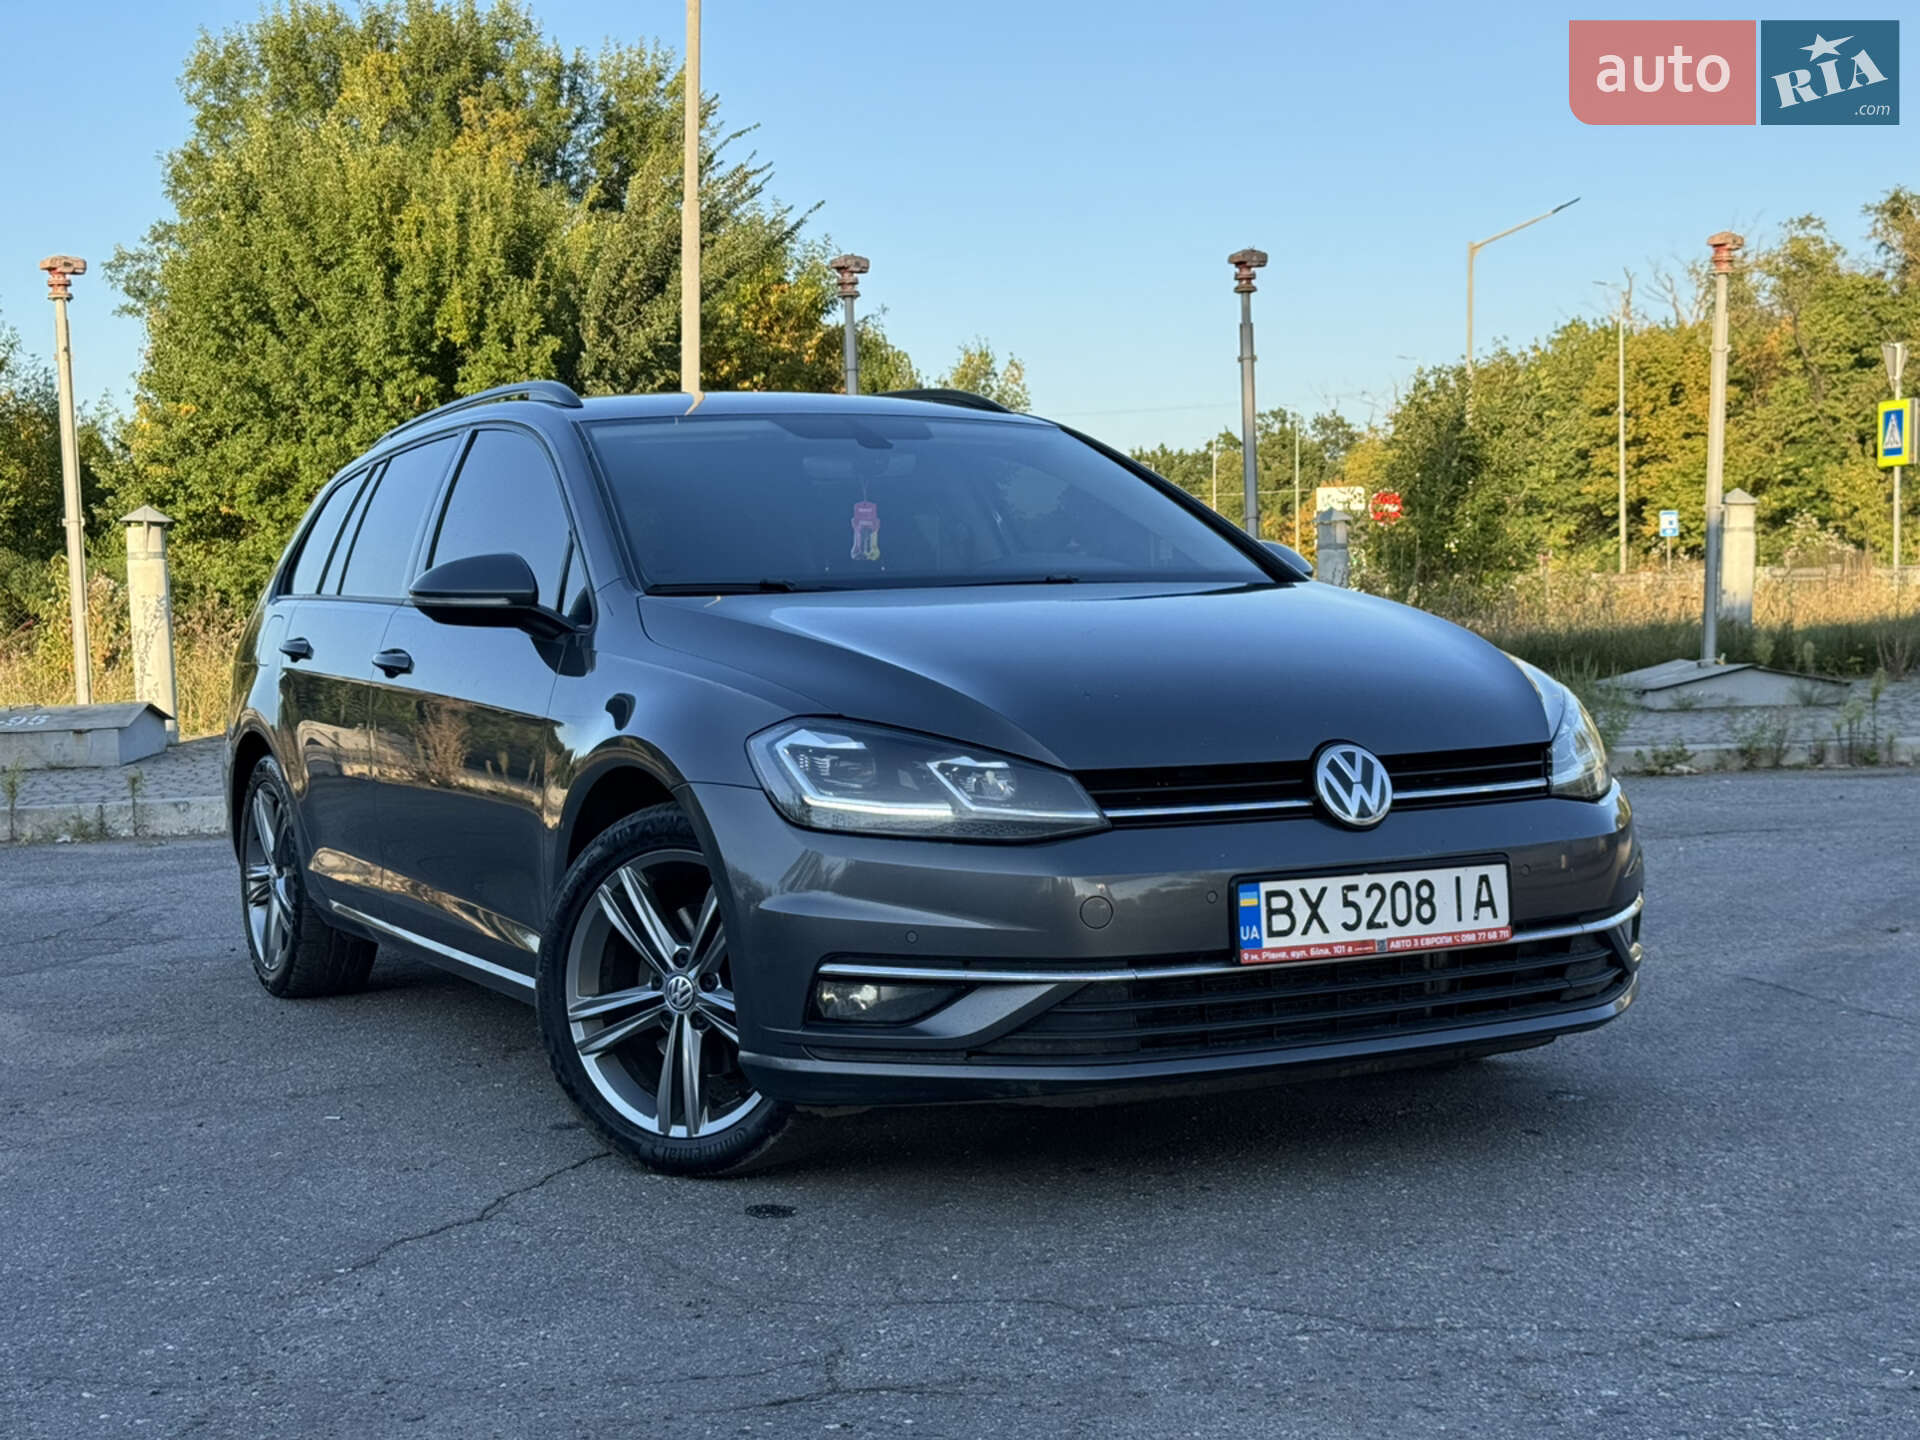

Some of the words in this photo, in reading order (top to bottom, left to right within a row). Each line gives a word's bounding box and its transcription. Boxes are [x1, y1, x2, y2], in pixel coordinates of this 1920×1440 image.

[1264, 886, 1330, 938] BX
[1341, 879, 1437, 932] 5208
[1455, 873, 1498, 922] IA
[1240, 925, 1260, 941] UA
